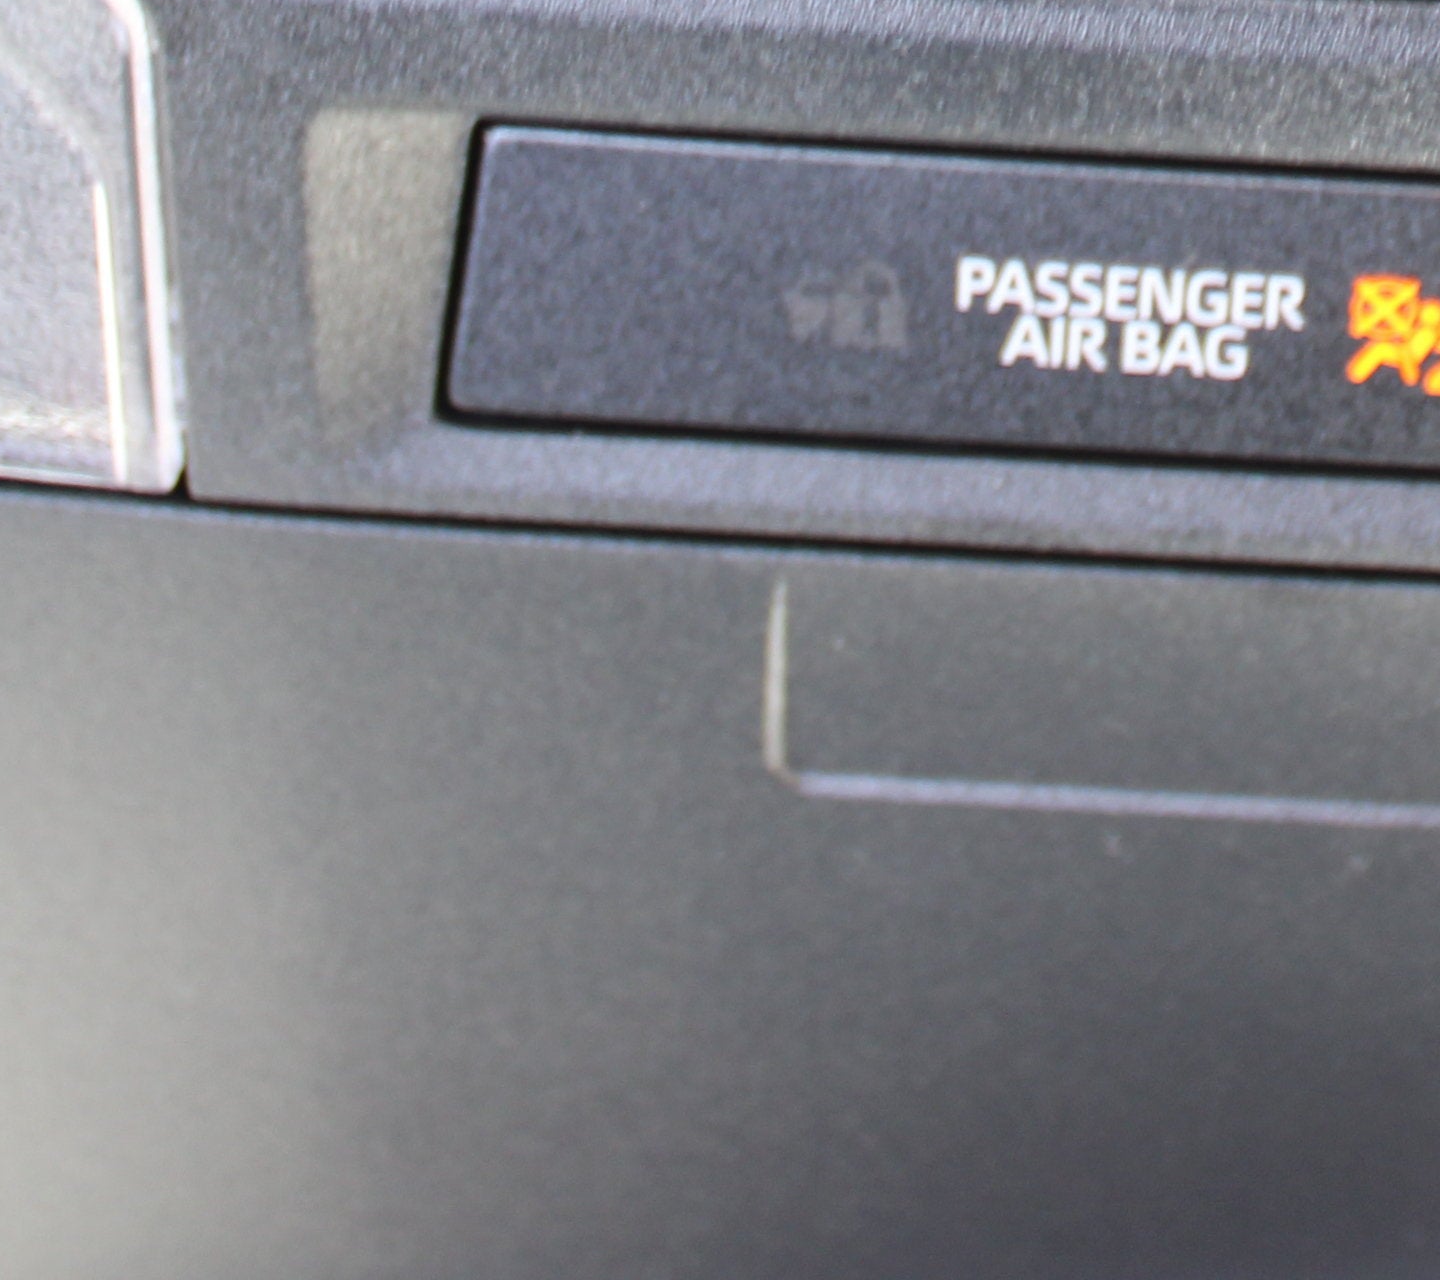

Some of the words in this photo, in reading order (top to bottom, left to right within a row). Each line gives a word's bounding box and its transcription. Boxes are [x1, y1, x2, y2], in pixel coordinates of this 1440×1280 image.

[954, 254, 1307, 333] PASSENGER
[998, 313, 1108, 374] AIR
[1119, 319, 1250, 382] BAG
